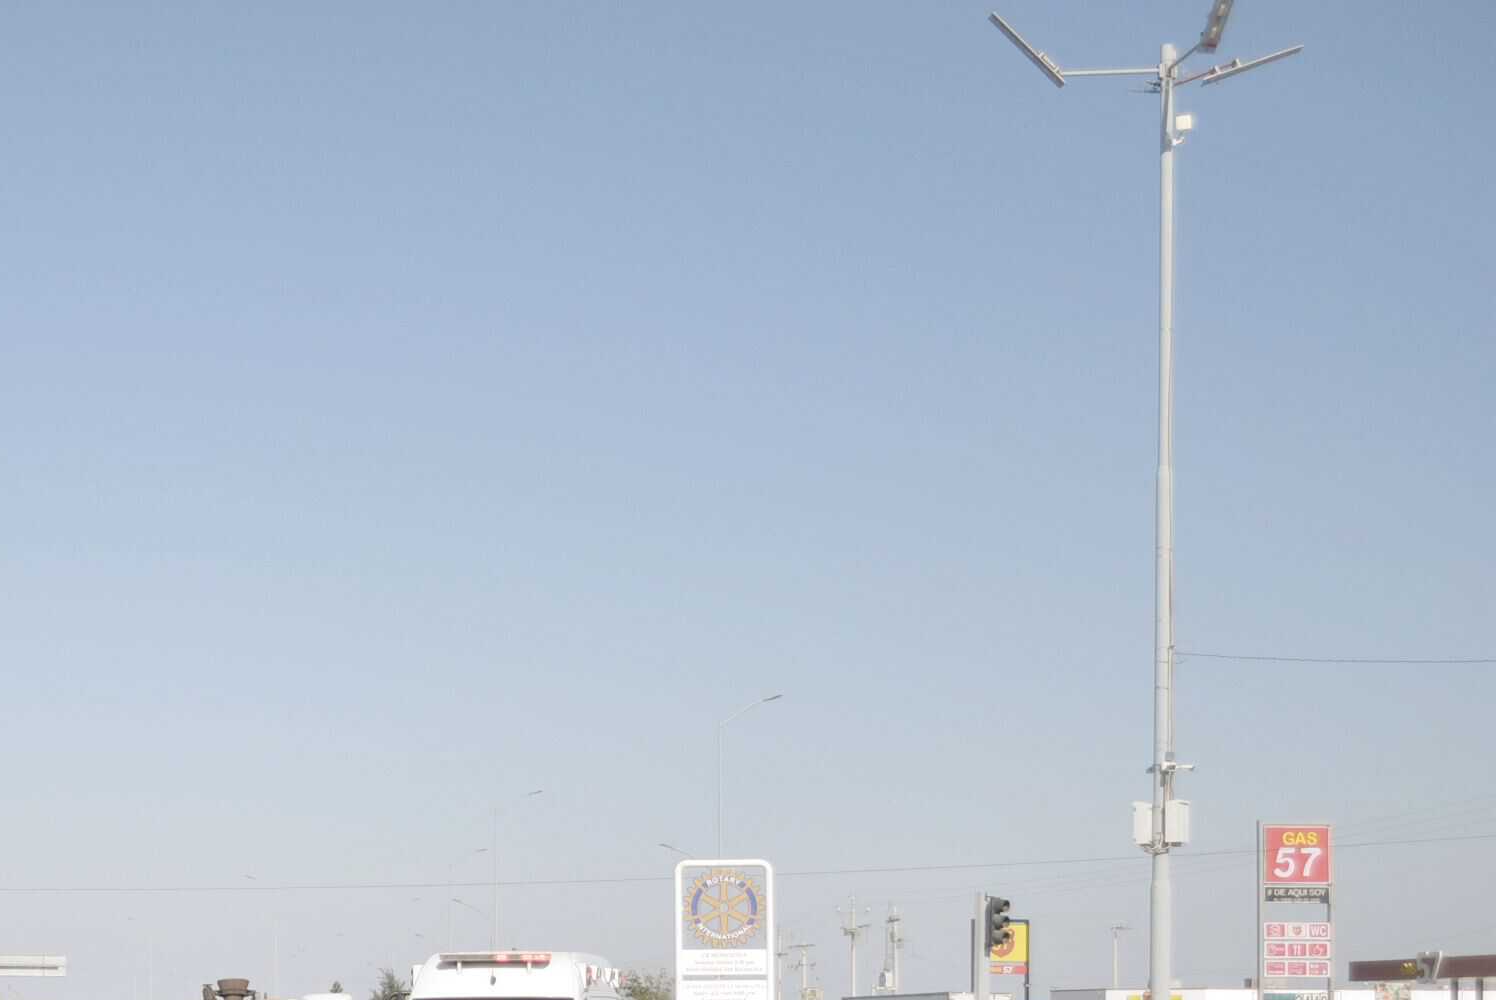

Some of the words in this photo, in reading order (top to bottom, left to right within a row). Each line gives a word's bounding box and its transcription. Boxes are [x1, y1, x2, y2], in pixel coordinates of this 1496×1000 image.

[1282, 831, 1318, 845] GAS
[1273, 847, 1322, 878] 57
[1311, 926, 1327, 937] WC
